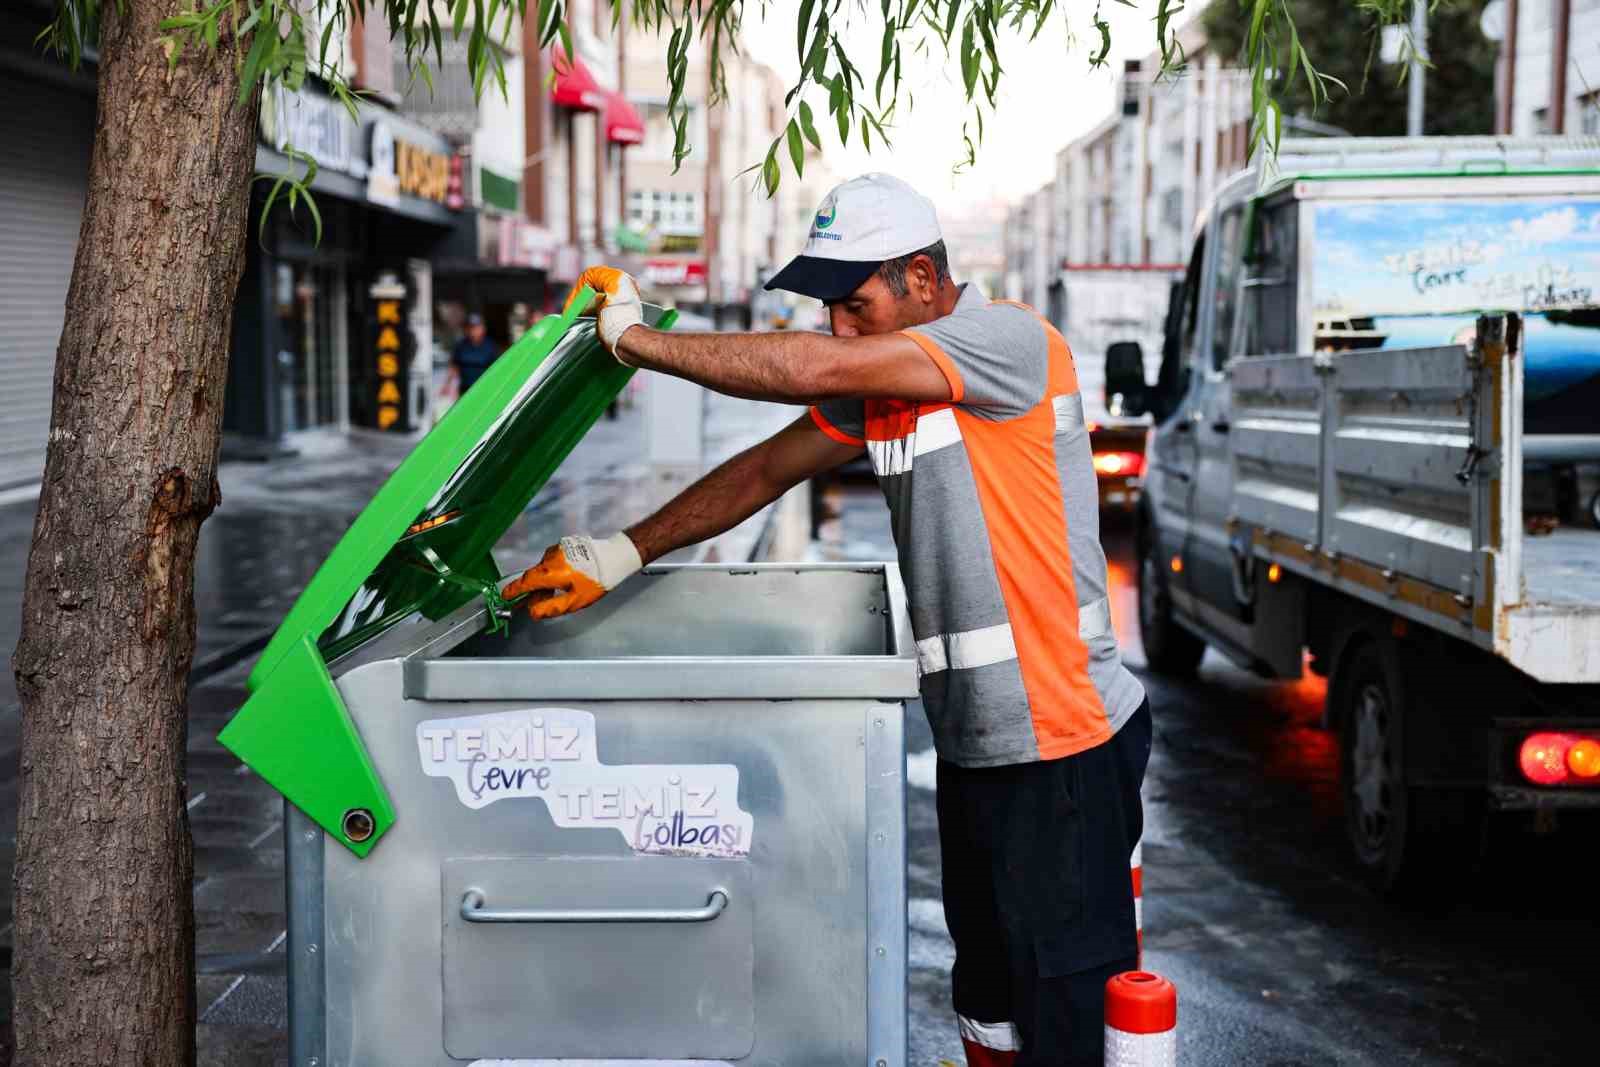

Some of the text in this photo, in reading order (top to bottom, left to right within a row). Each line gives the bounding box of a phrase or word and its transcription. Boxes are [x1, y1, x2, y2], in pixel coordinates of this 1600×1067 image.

[377, 299, 401, 431] KASAP
[423, 716, 582, 762] TEMİZ
[467, 752, 551, 801] Çevre
[559, 775, 720, 820] TEMİZ
